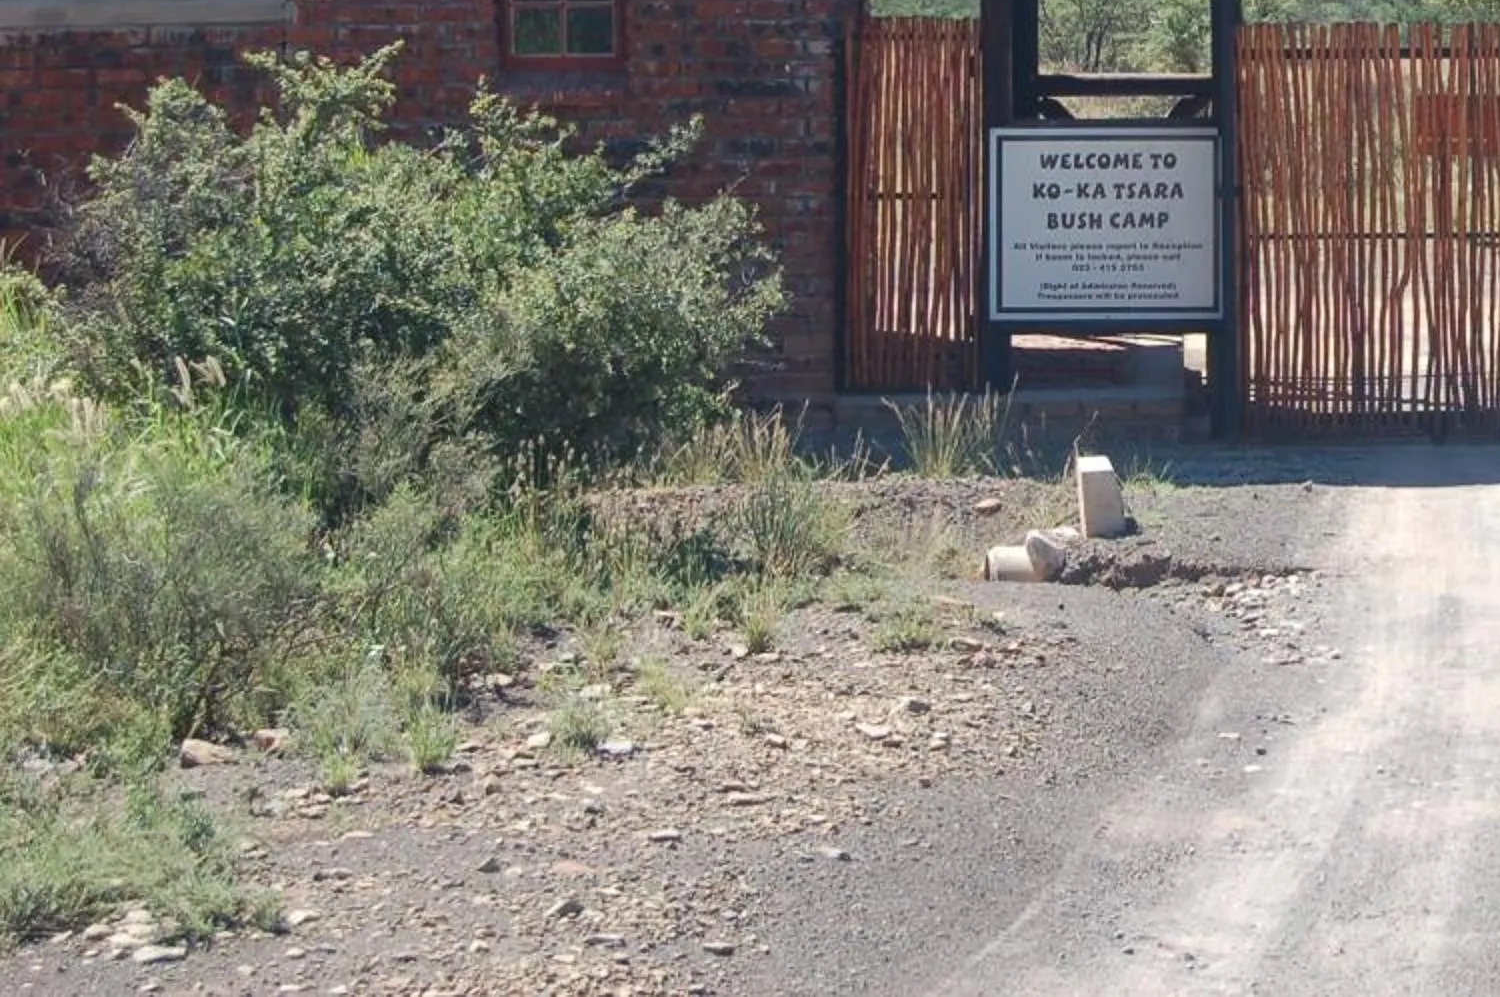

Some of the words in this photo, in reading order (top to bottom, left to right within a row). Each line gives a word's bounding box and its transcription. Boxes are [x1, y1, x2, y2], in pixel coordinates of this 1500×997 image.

[1039, 153, 1143, 170] WELCOME
[1150, 153, 1177, 169] TO
[1032, 182, 1107, 200] KO-KA
[1113, 182, 1184, 200] TSARA
[1047, 212, 1103, 230] BUSH
[1109, 211, 1169, 229] CAMP
